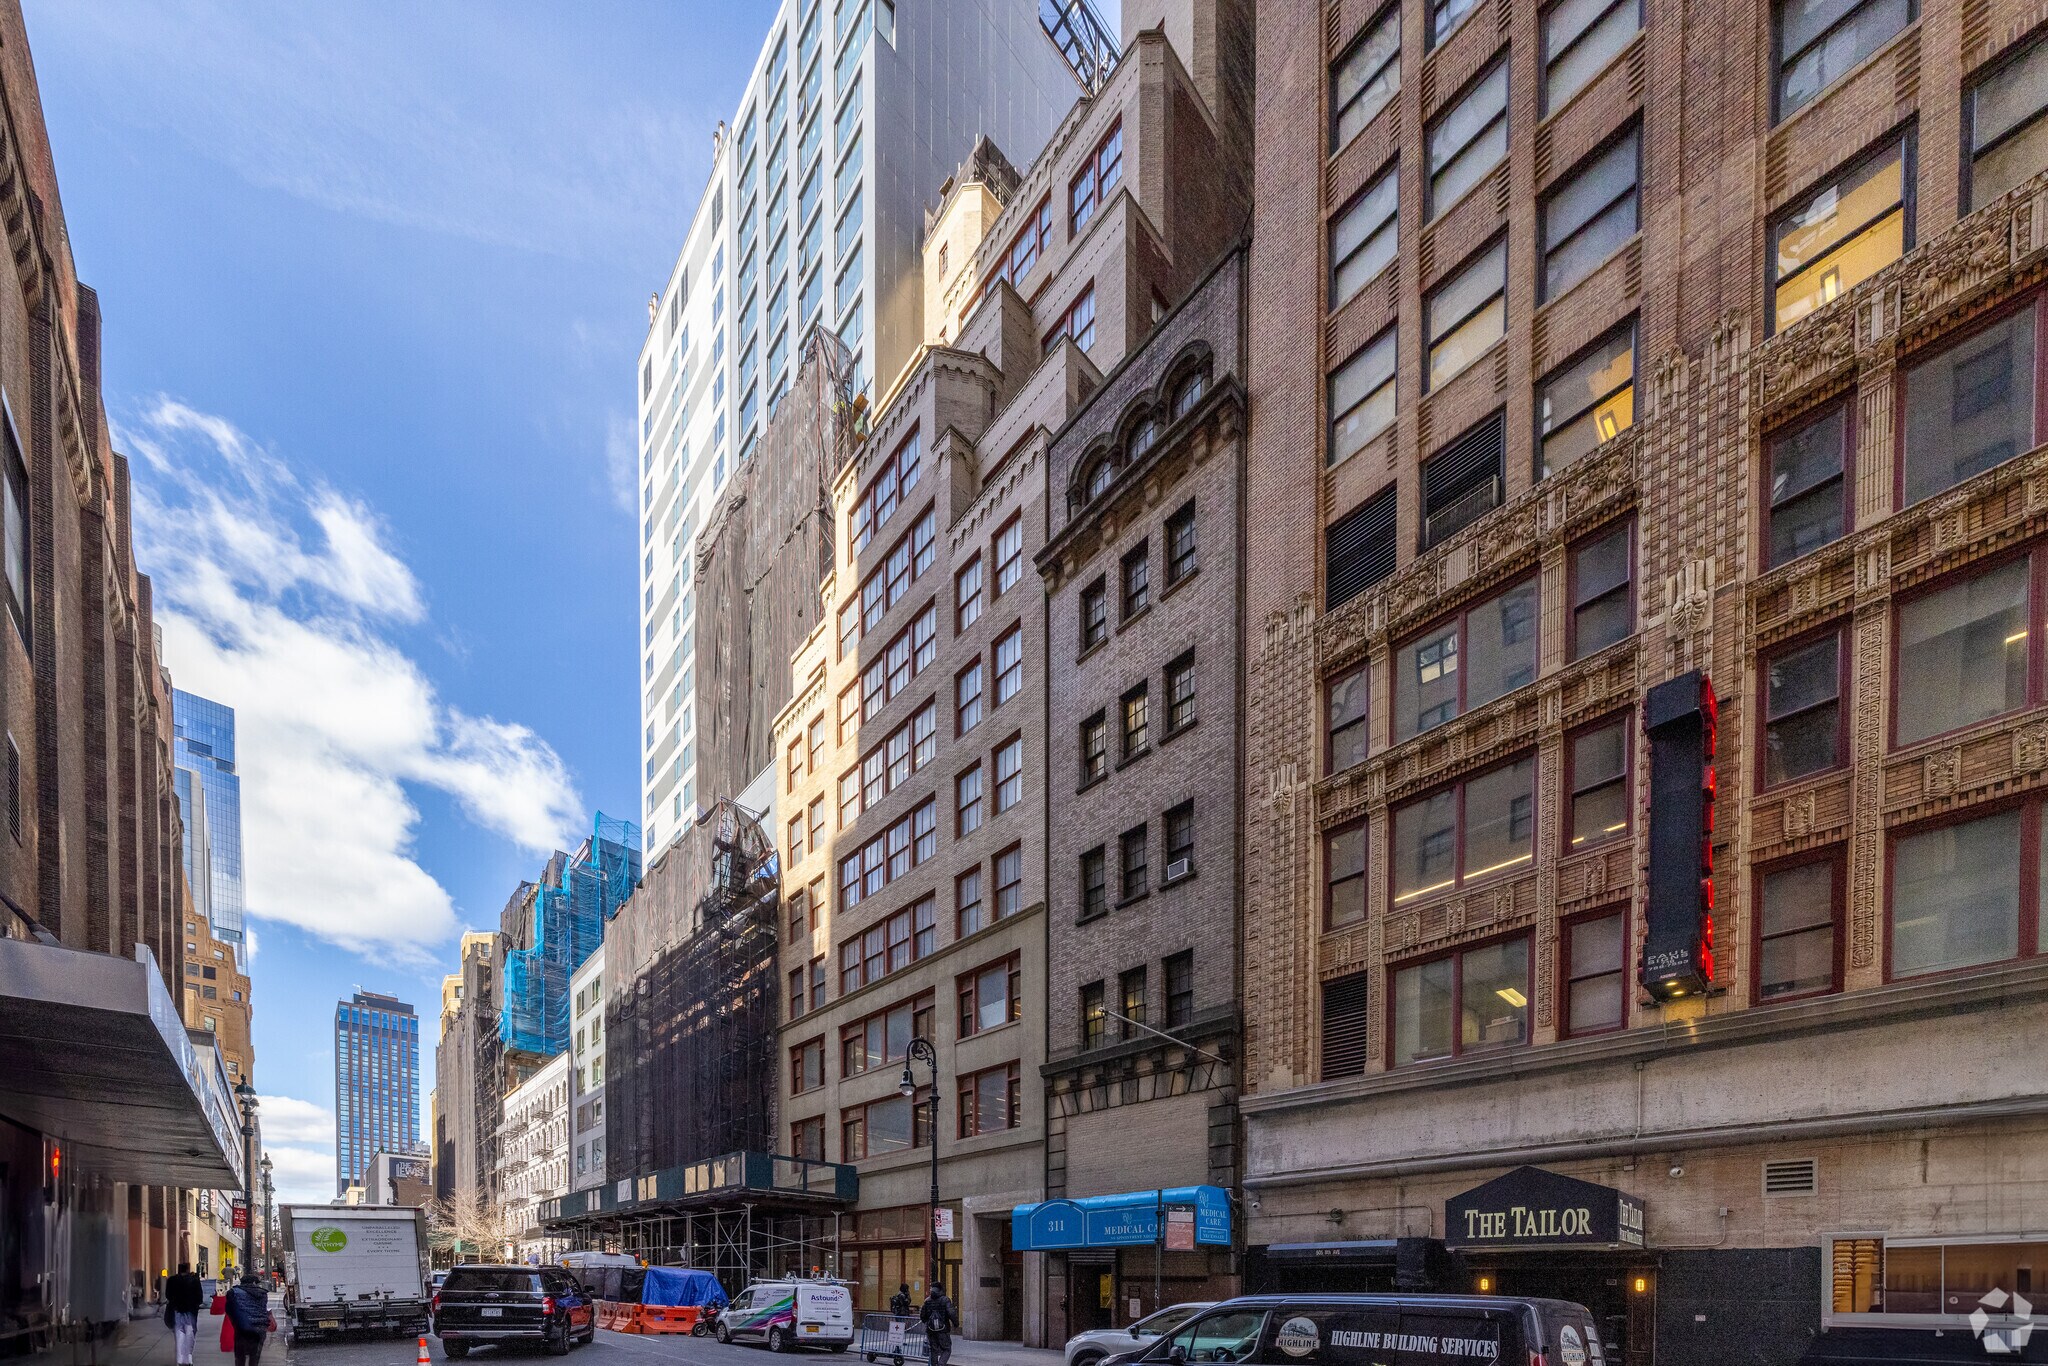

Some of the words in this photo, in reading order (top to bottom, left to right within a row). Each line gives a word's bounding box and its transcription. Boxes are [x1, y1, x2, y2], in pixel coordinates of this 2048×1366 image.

[1200, 1208, 1228, 1219] MEDICAL
[1048, 1220, 1064, 1232] 311
[1205, 1218, 1222, 1227] CARE
[1464, 1209, 1506, 1238] THE
[1511, 1206, 1593, 1237] TAILOR
[1104, 1223, 1145, 1236] MEDICAL
[1147, 1222, 1165, 1233] CAR
[1278, 1339, 1317, 1348] HIGHLINE
[1331, 1330, 1381, 1349] HIGHLINE
[1382, 1333, 1438, 1353] BUILDING
[1441, 1337, 1498, 1358] SERVICES
